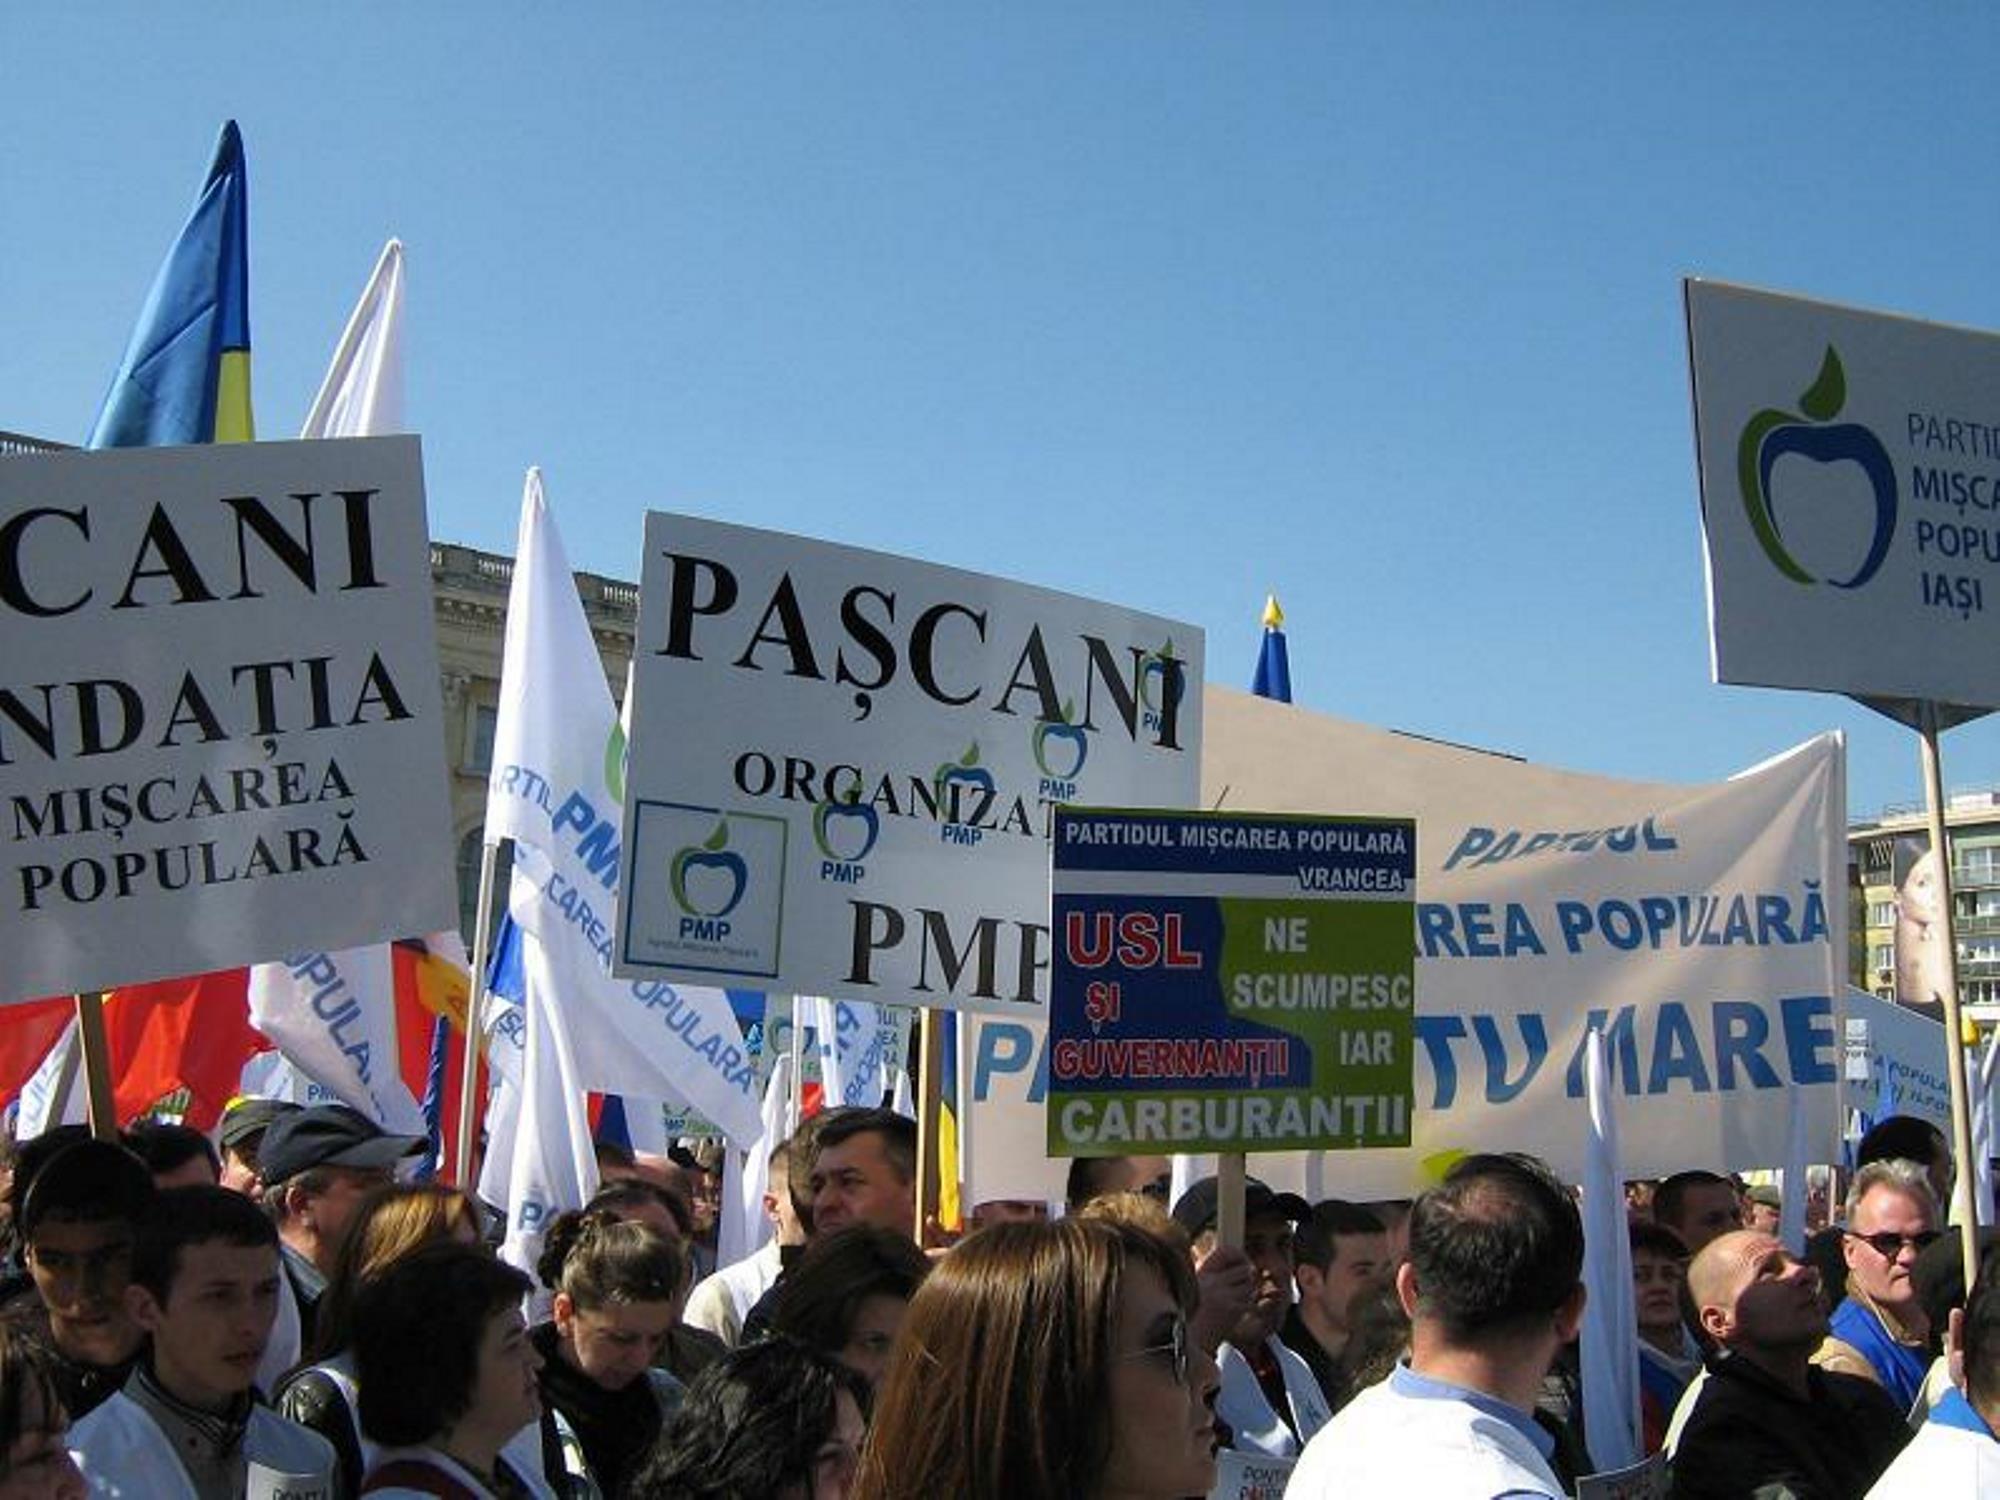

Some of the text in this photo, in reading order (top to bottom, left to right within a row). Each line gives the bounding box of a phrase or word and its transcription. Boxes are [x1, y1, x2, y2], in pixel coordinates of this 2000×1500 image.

[0, 488, 390, 617] CANI
[1922, 571, 1983, 621] IAȘI
[655, 552, 1186, 751] PAȘCANI
[10, 757, 354, 843] MIȘCAREA
[1038, 779, 1076, 800] PMP
[19, 811, 370, 910] POPULARĂ
[941, 824, 983, 848] PMP
[1066, 822, 1407, 855] PARTIDUL MIȘCAREA POPULARĂ
[820, 861, 866, 884] PMP
[1300, 866, 1404, 891] VRANCEA
[541, 872, 613, 968] CAREA
[679, 917, 732, 942] PMP
[1066, 911, 1202, 970] USL
[1264, 917, 1308, 953] NE
[1414, 879, 1830, 958] REA POPULARĂ
[839, 899, 1049, 1005] PMP
[1085, 980, 1121, 1034] ȘI
[1232, 973, 1411, 1011] SCUMPESC
[1054, 1038, 1289, 1088] GUVERNANȚII
[1340, 1031, 1394, 1066] IAR
[1566, 995, 1836, 1099] MARE
[1060, 1096, 1405, 1146] CARBURANȚII
